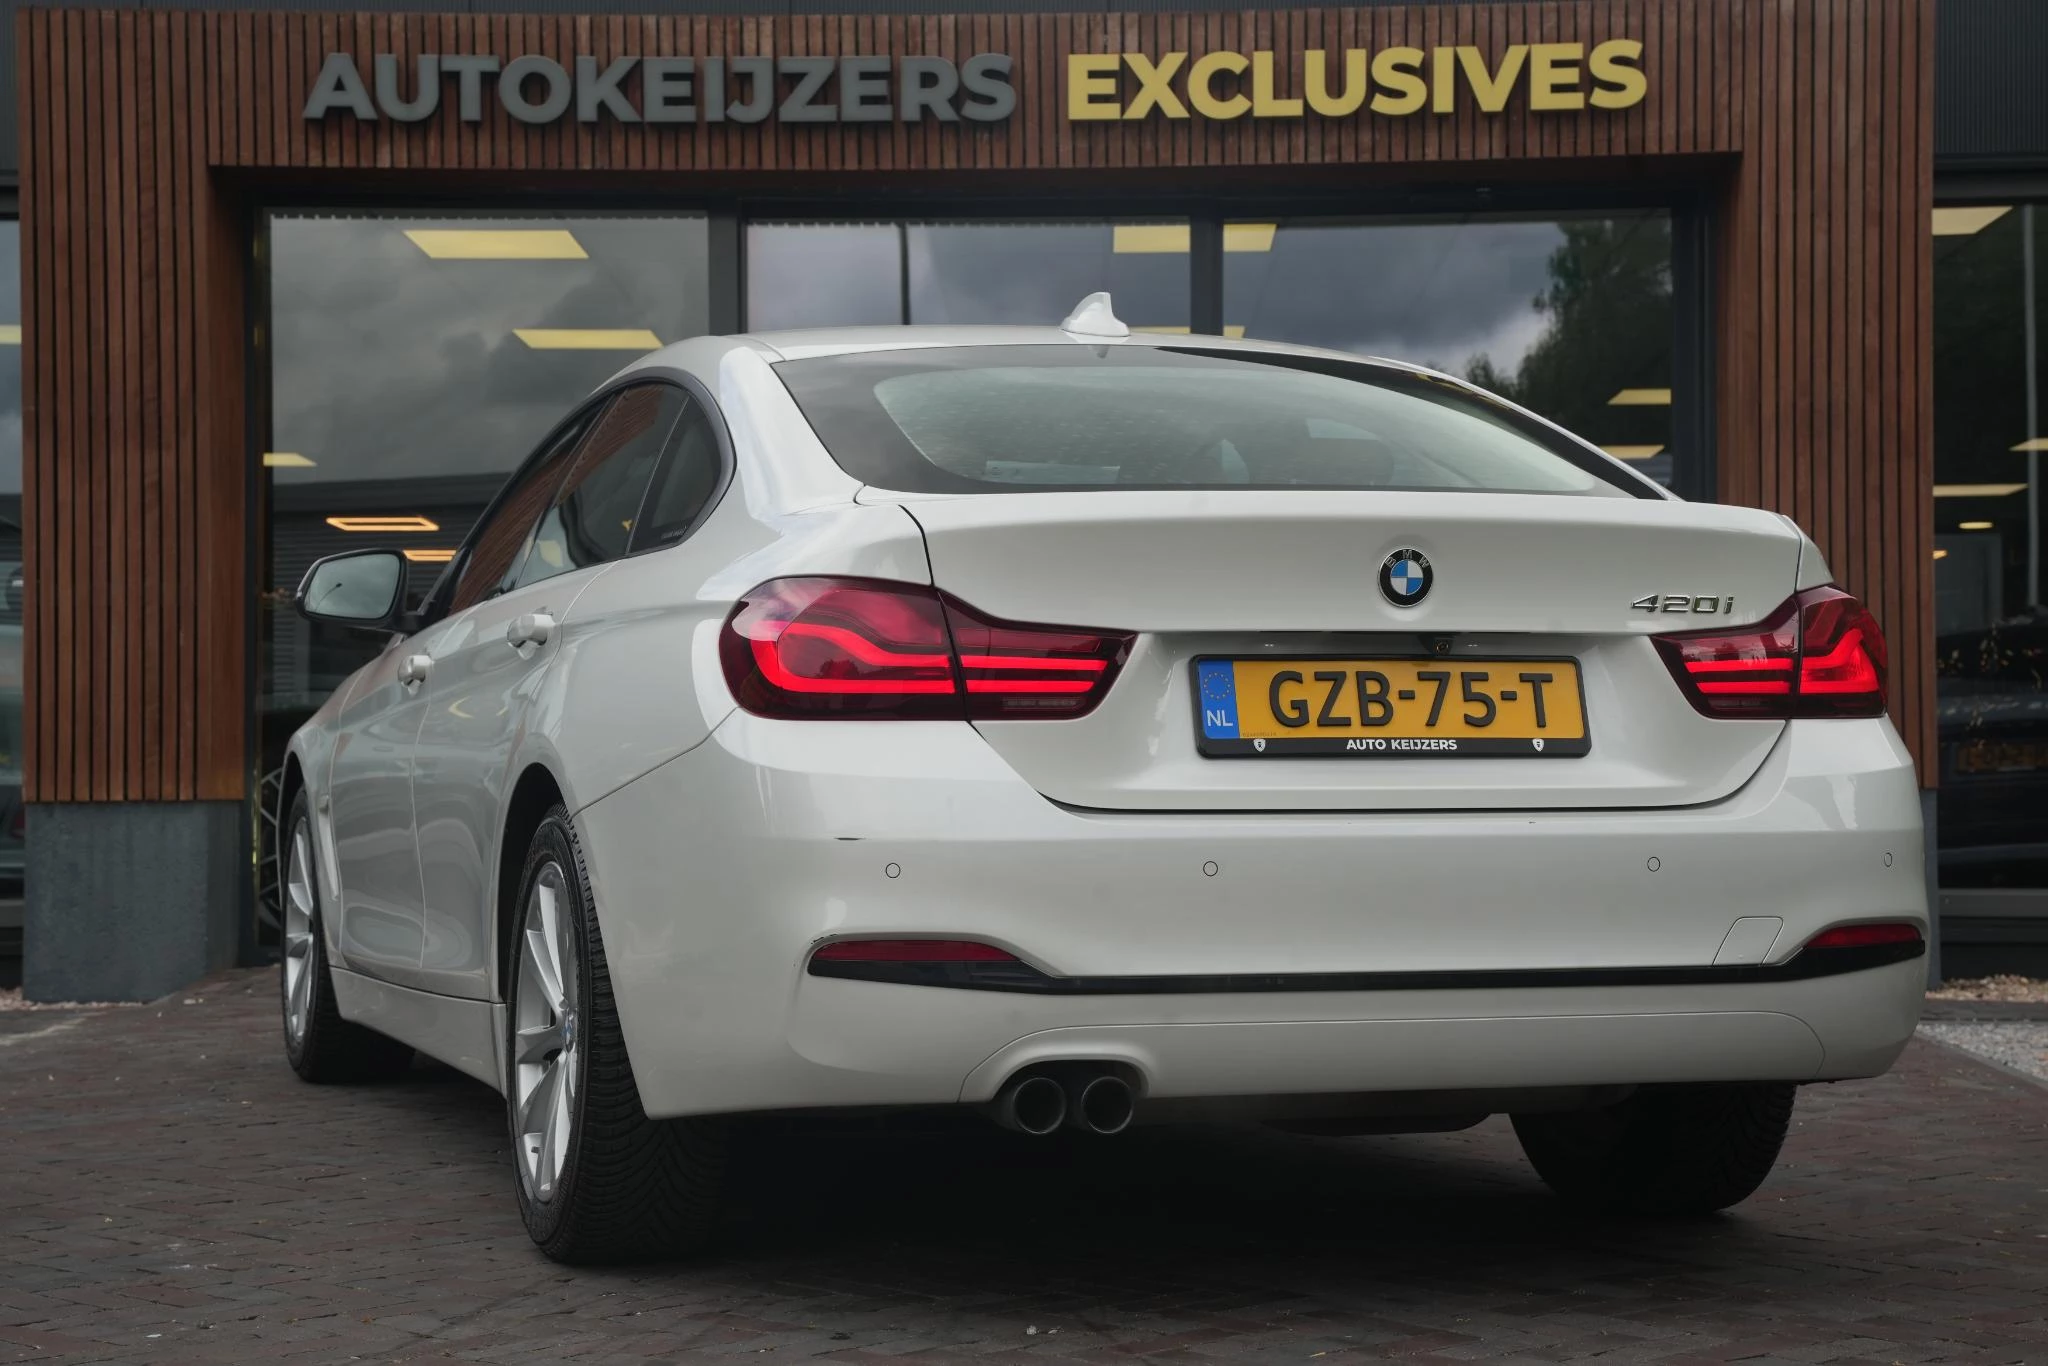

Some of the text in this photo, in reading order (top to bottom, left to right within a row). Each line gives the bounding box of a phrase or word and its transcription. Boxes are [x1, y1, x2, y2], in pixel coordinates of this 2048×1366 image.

[303, 39, 1648, 124] AUTOKEIJZERS EXCLUSIVES
[1631, 594, 1735, 615] 420i
[1269, 670, 1553, 728] GZB-75-T
[1206, 709, 1234, 727] NL
[1346, 739, 1458, 750] AUTO KEIJZERS
